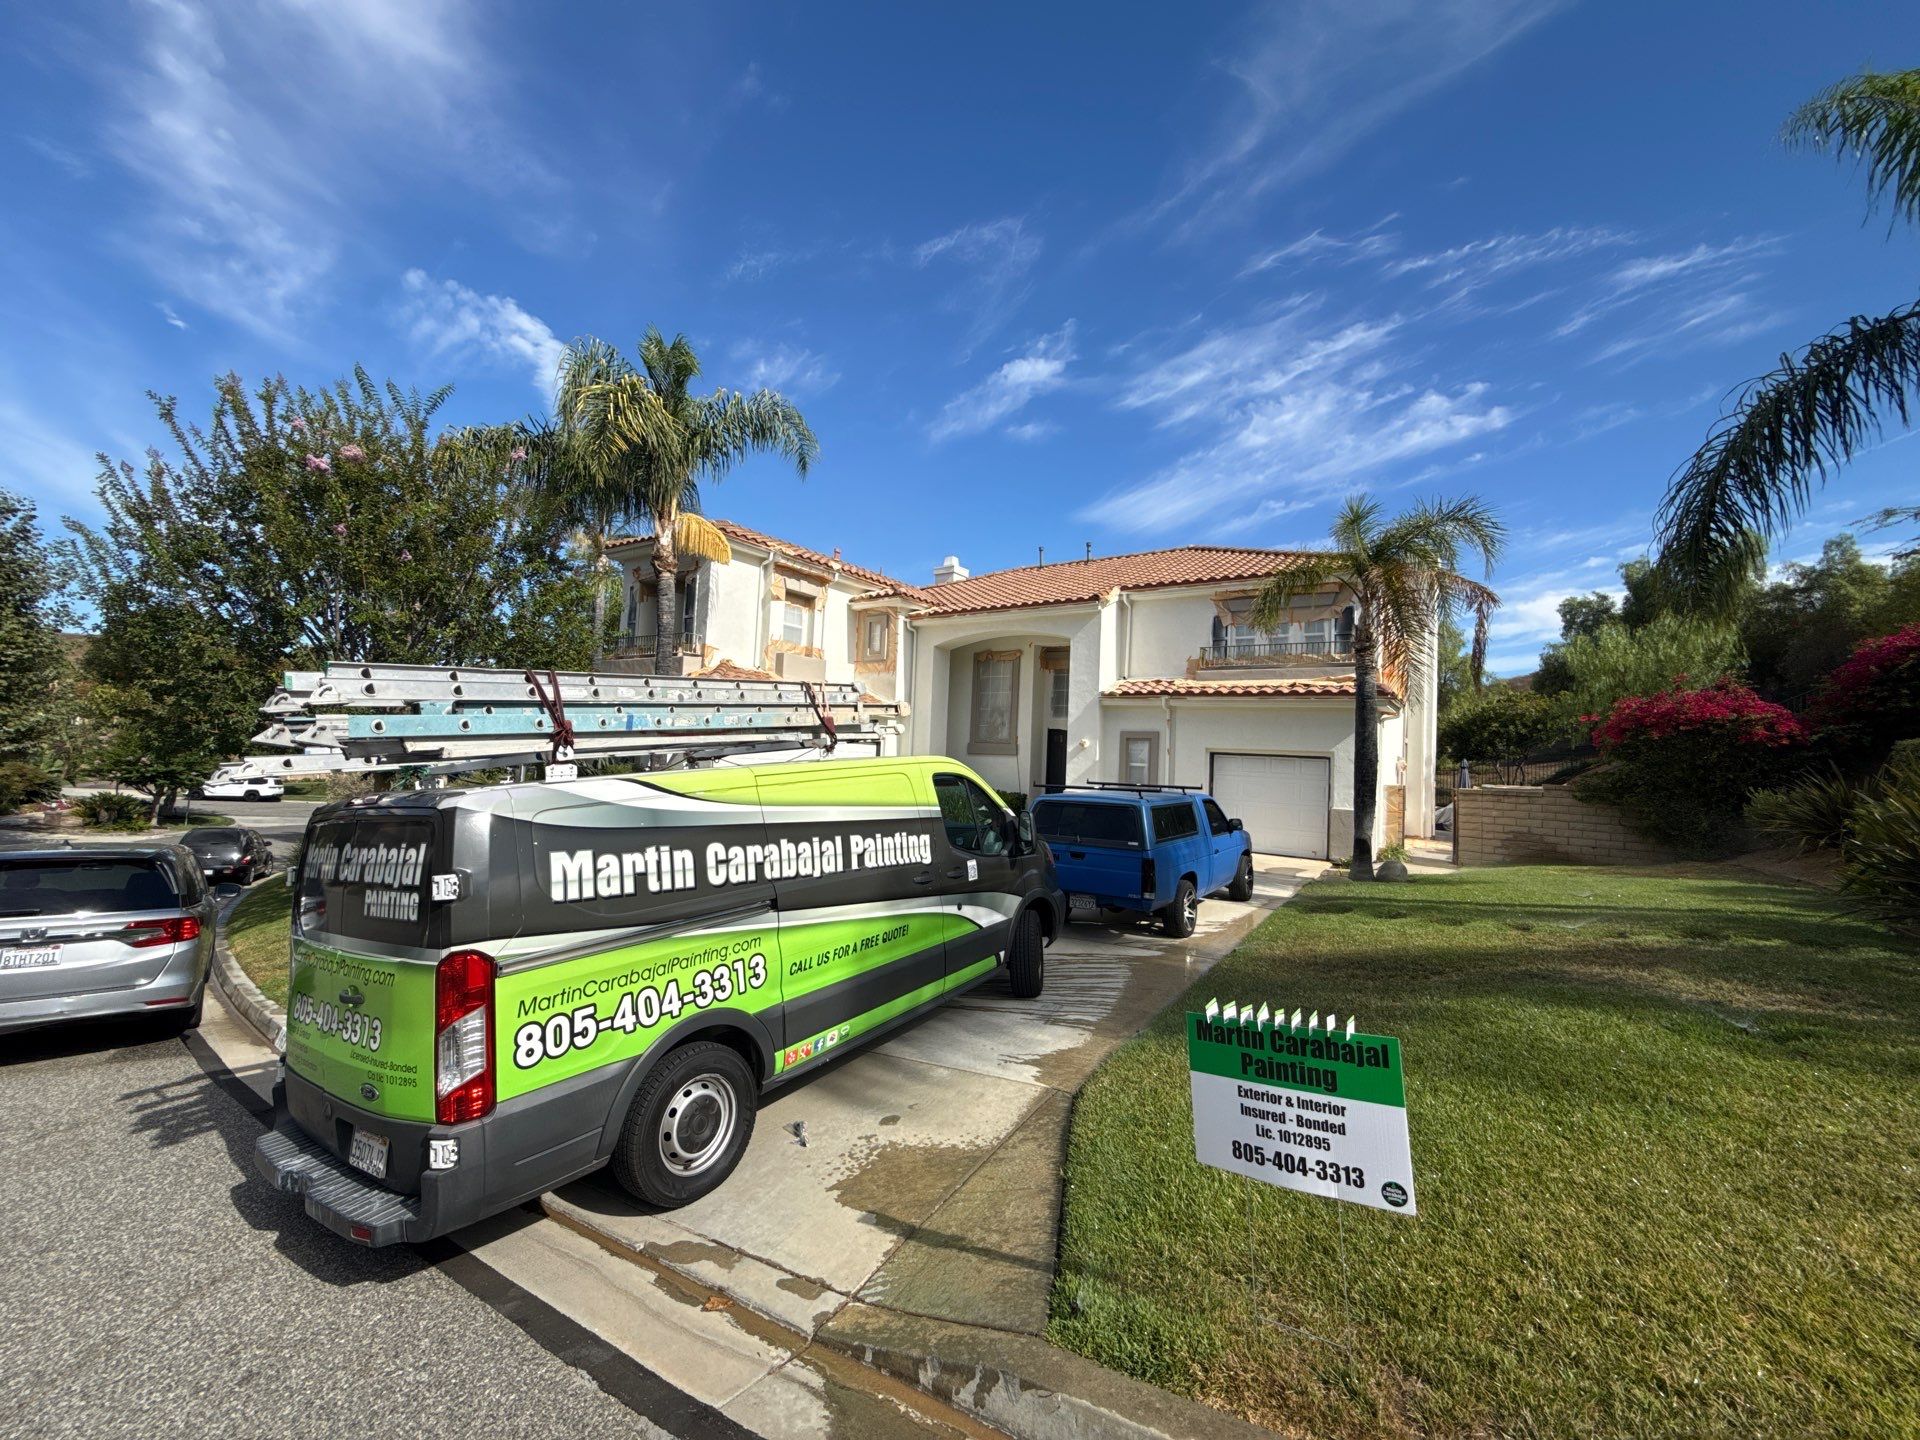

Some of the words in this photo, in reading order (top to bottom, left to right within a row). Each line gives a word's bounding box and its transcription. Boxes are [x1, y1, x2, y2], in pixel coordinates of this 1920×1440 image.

[304, 843, 339, 879] Martin
[339, 842, 426, 888] Carabajal
[549, 845, 698, 903] Martin
[706, 834, 843, 888] Carabajal
[849, 832, 932, 870] Painting
[364, 889, 420, 921] PAINTING
[3, 952, 58, 966] 8THT201
[789, 957, 813, 976] CALL
[817, 951, 831, 966] US
[833, 945, 850, 961] FOR
[851, 942, 857, 954] A
[860, 934, 880, 951] FREE
[882, 924, 909, 944] QUOTE!
[518, 936, 761, 1018] MartinCarabajalPainting.com
[293, 991, 382, 1052] 805-404-3313
[514, 953, 767, 1069] 805-404-3313
[1196, 1019, 1265, 1051] Martin
[1270, 1030, 1390, 1069] Carabajal
[386, 1074, 418, 1088] 1012895
[1240, 1052, 1338, 1093] Painting
[1237, 1085, 1283, 1106] Exterior
[1286, 1095, 1294, 1108] &
[1297, 1096, 1347, 1117] Interior
[1240, 1103, 1286, 1125] Insured
[1296, 1114, 1346, 1136] Bonded
[1255, 1123, 1276, 1140] Lic.
[1278, 1129, 1331, 1152] 1012895
[1231, 1140, 1365, 1189] 805-404-3313
